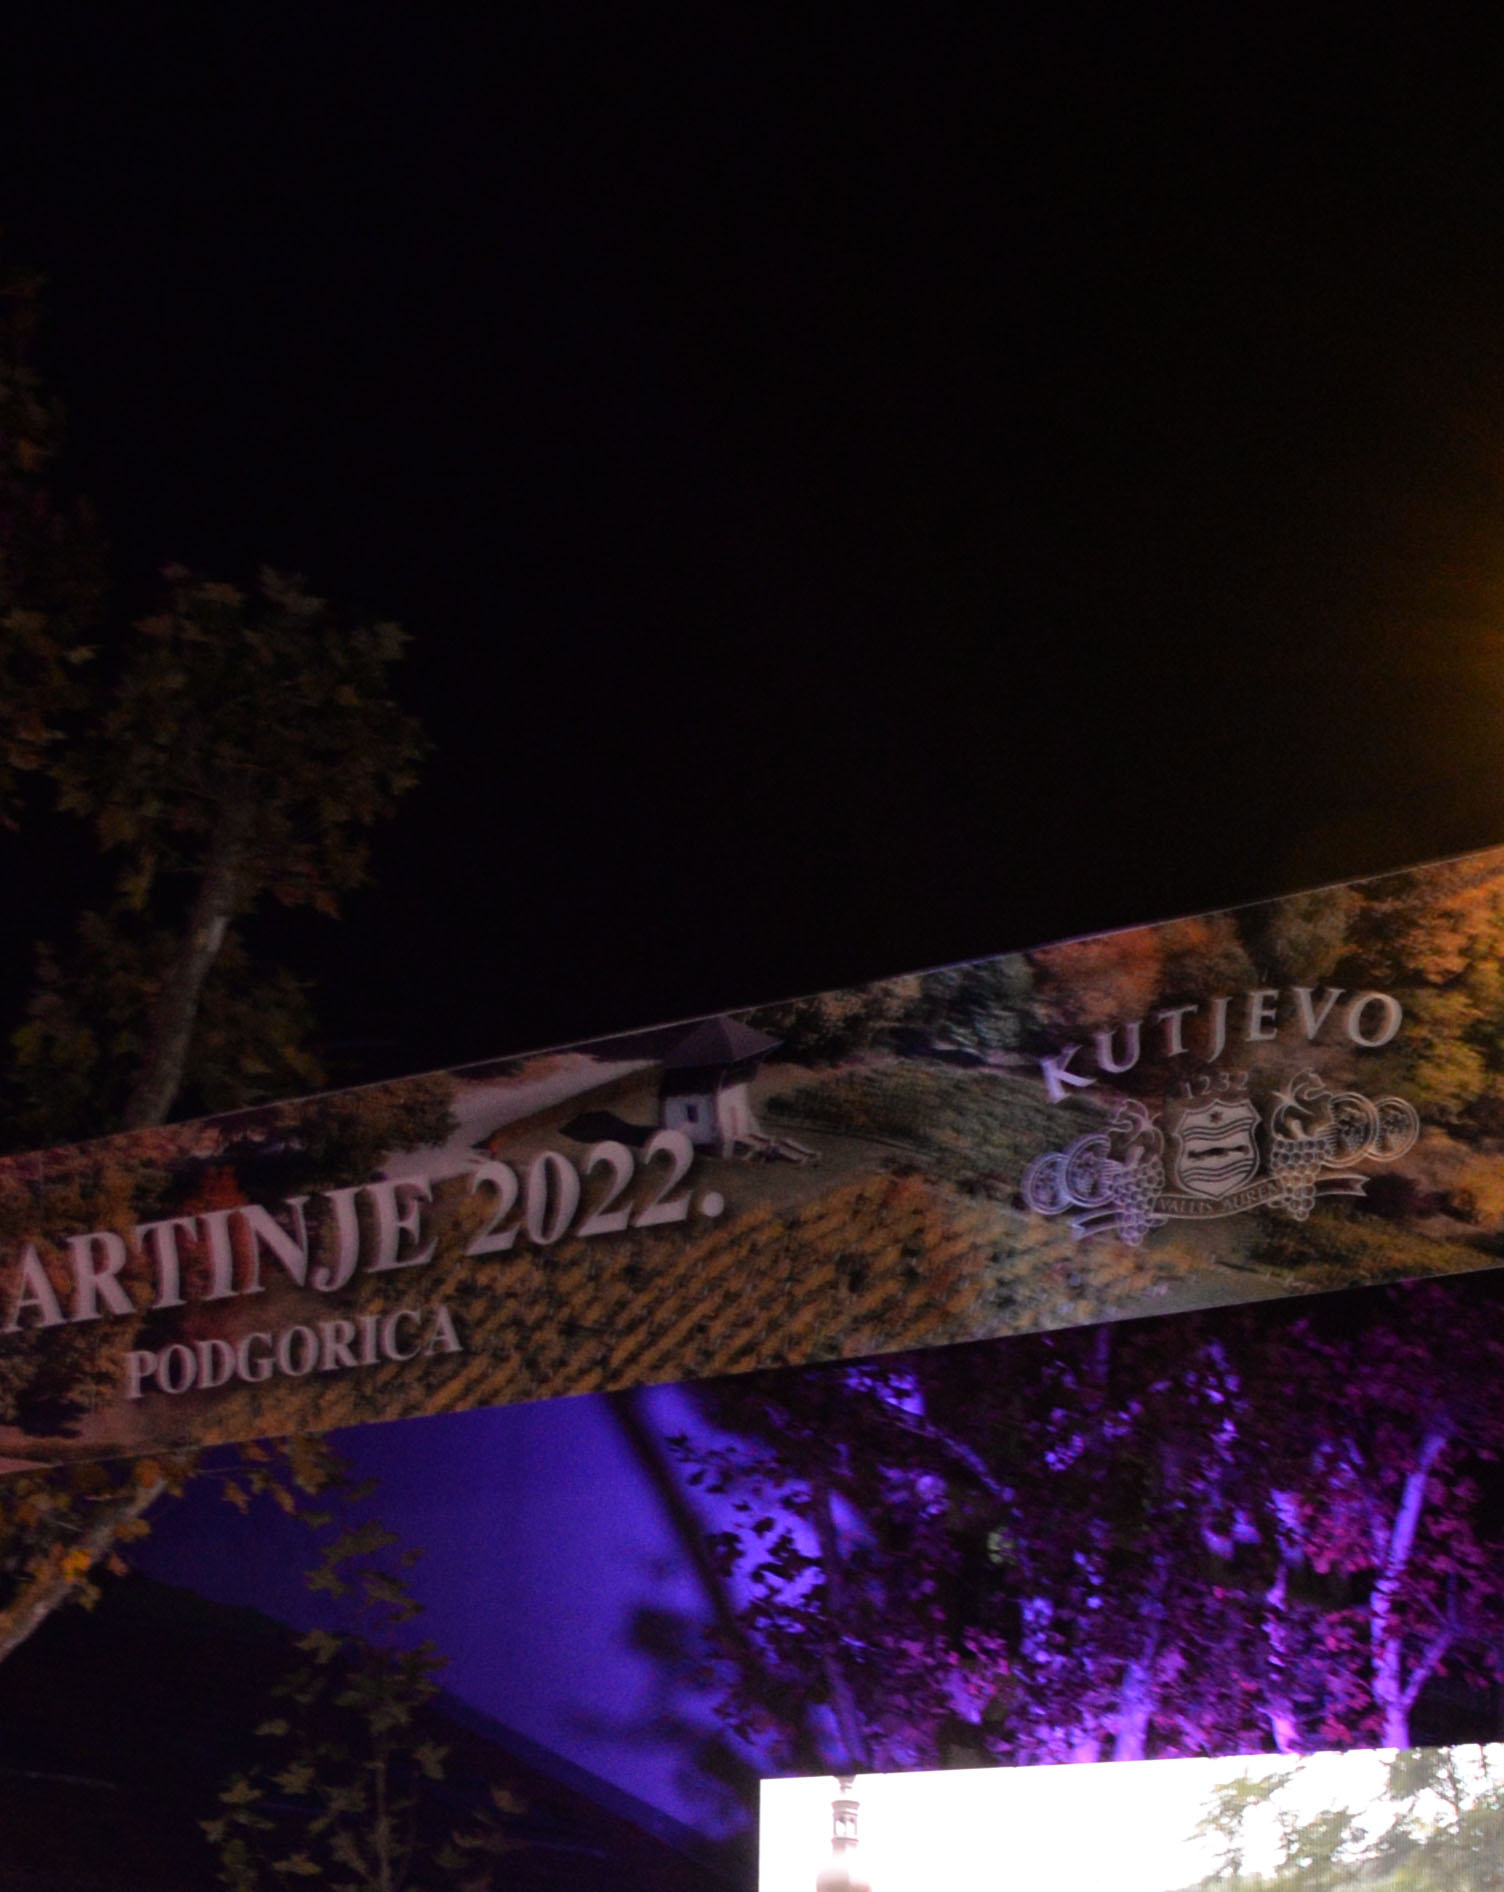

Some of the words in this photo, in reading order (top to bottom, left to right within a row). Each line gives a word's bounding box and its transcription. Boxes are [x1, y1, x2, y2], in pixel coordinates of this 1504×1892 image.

[1039, 986, 1404, 1103] KUTJEVO
[1179, 1070, 1249, 1098] 1232
[463, 1128, 725, 1255] 2022.
[124, 1304, 465, 1402] PODGORICA
